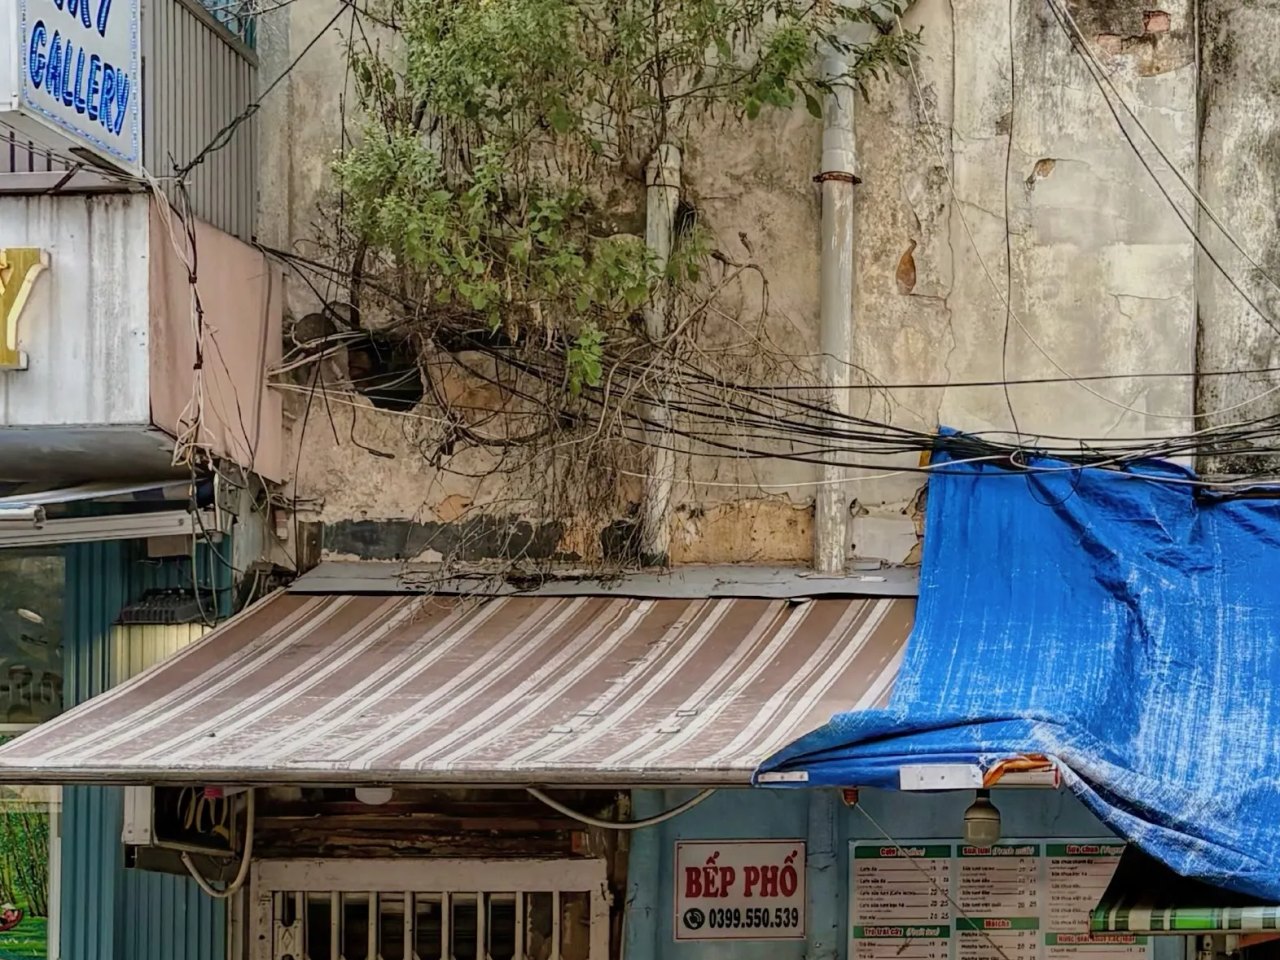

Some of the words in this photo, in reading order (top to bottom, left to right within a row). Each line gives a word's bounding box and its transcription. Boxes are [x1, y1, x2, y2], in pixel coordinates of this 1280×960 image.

[29, 19, 130, 136] GALLERY
[685, 851, 735, 898] BẾP
[743, 850, 798, 898] PHỐ
[709, 907, 799, 928] 0399.550.539
